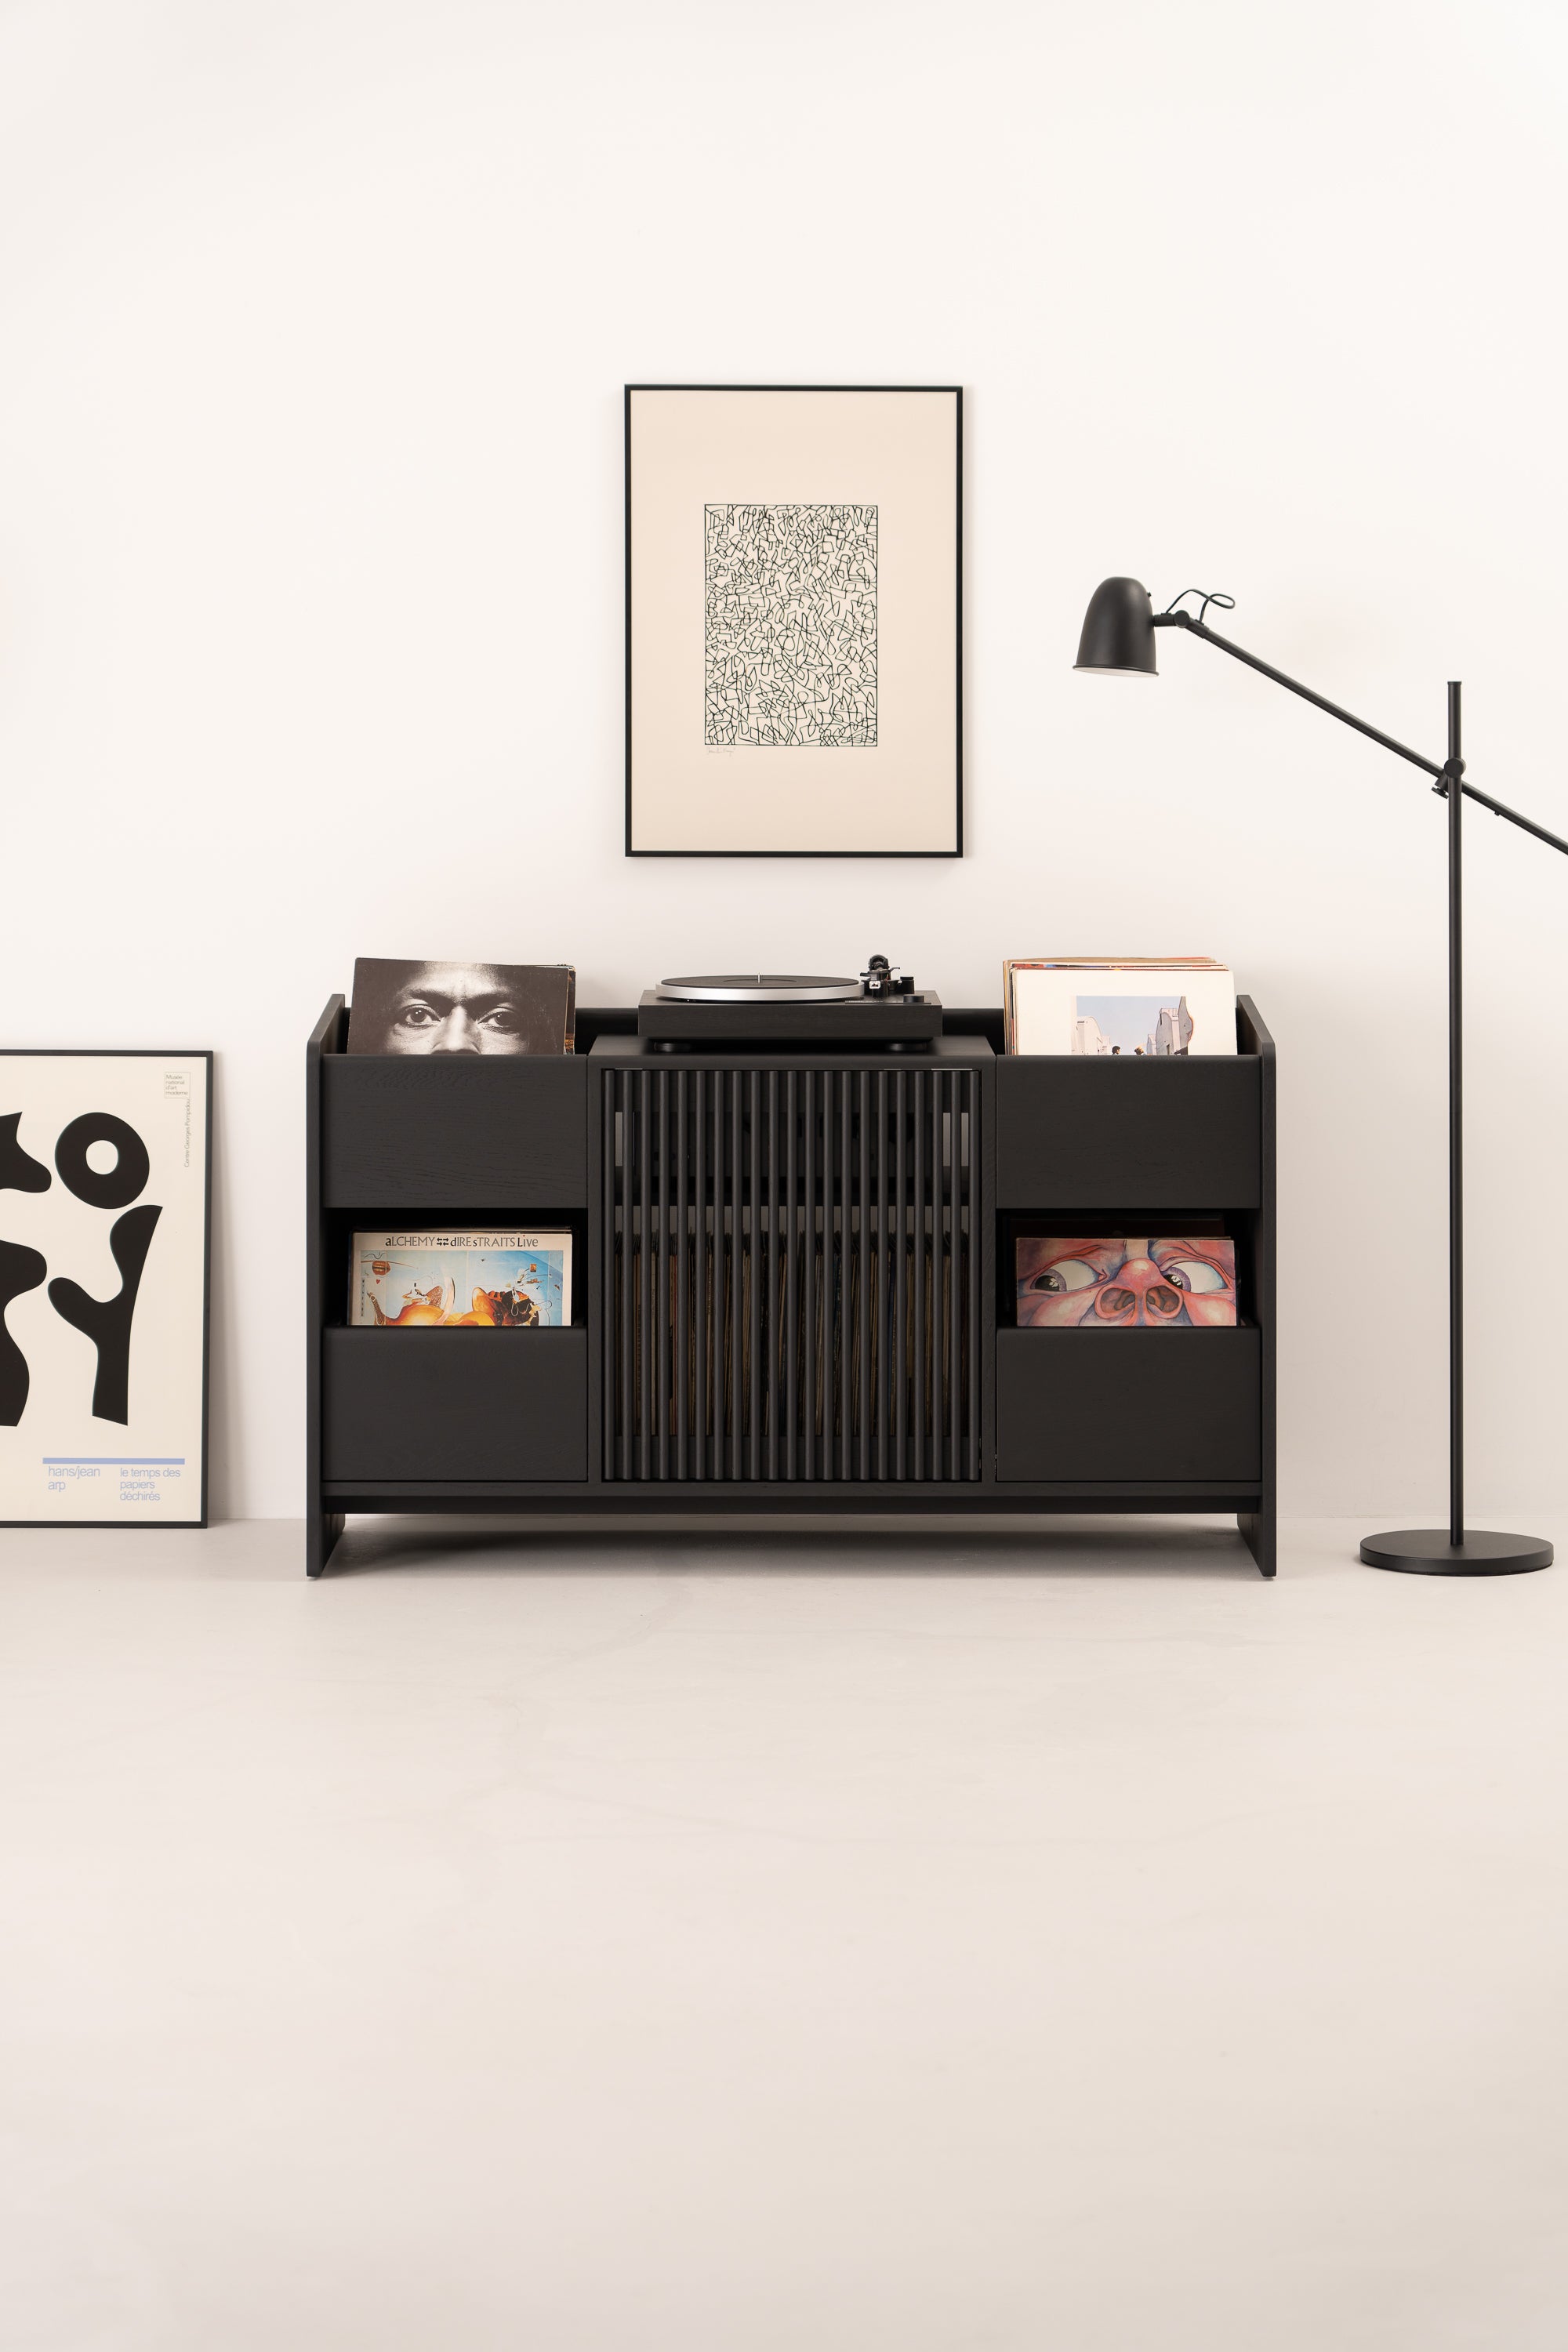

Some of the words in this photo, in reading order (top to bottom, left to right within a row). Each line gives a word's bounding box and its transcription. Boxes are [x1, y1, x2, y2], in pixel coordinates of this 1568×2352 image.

[517, 1235, 539, 1247] Live
[49, 1466, 100, 1479] hans/jean
[120, 1468, 129, 1477] le
[131, 1468, 161, 1479] temps
[163, 1468, 180, 1477] des
[48, 1481, 66, 1492] arp
[120, 1479, 155, 1491] papiers
[120, 1491, 161, 1501] déchirés
